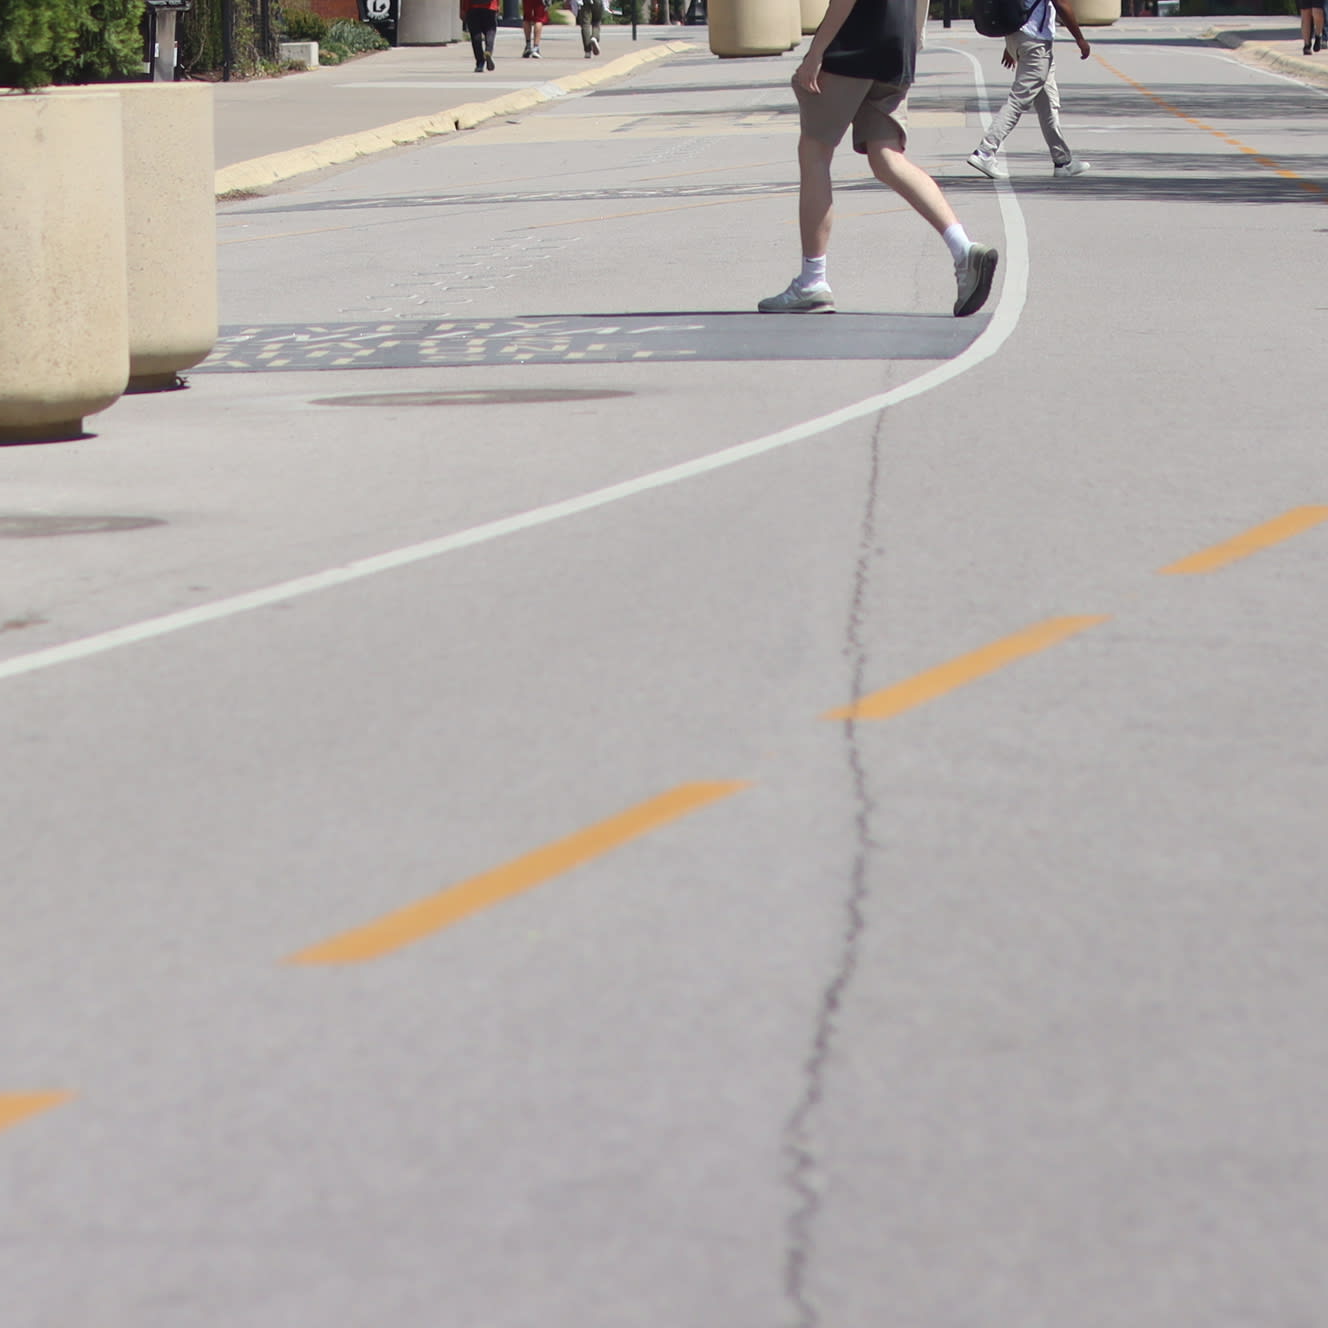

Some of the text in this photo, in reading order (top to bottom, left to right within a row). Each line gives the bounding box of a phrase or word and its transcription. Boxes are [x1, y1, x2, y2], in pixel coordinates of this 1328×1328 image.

[240, 320, 569, 334] EVERY
[205, 348, 377, 359] ITH
[191, 357, 386, 368] ALL
